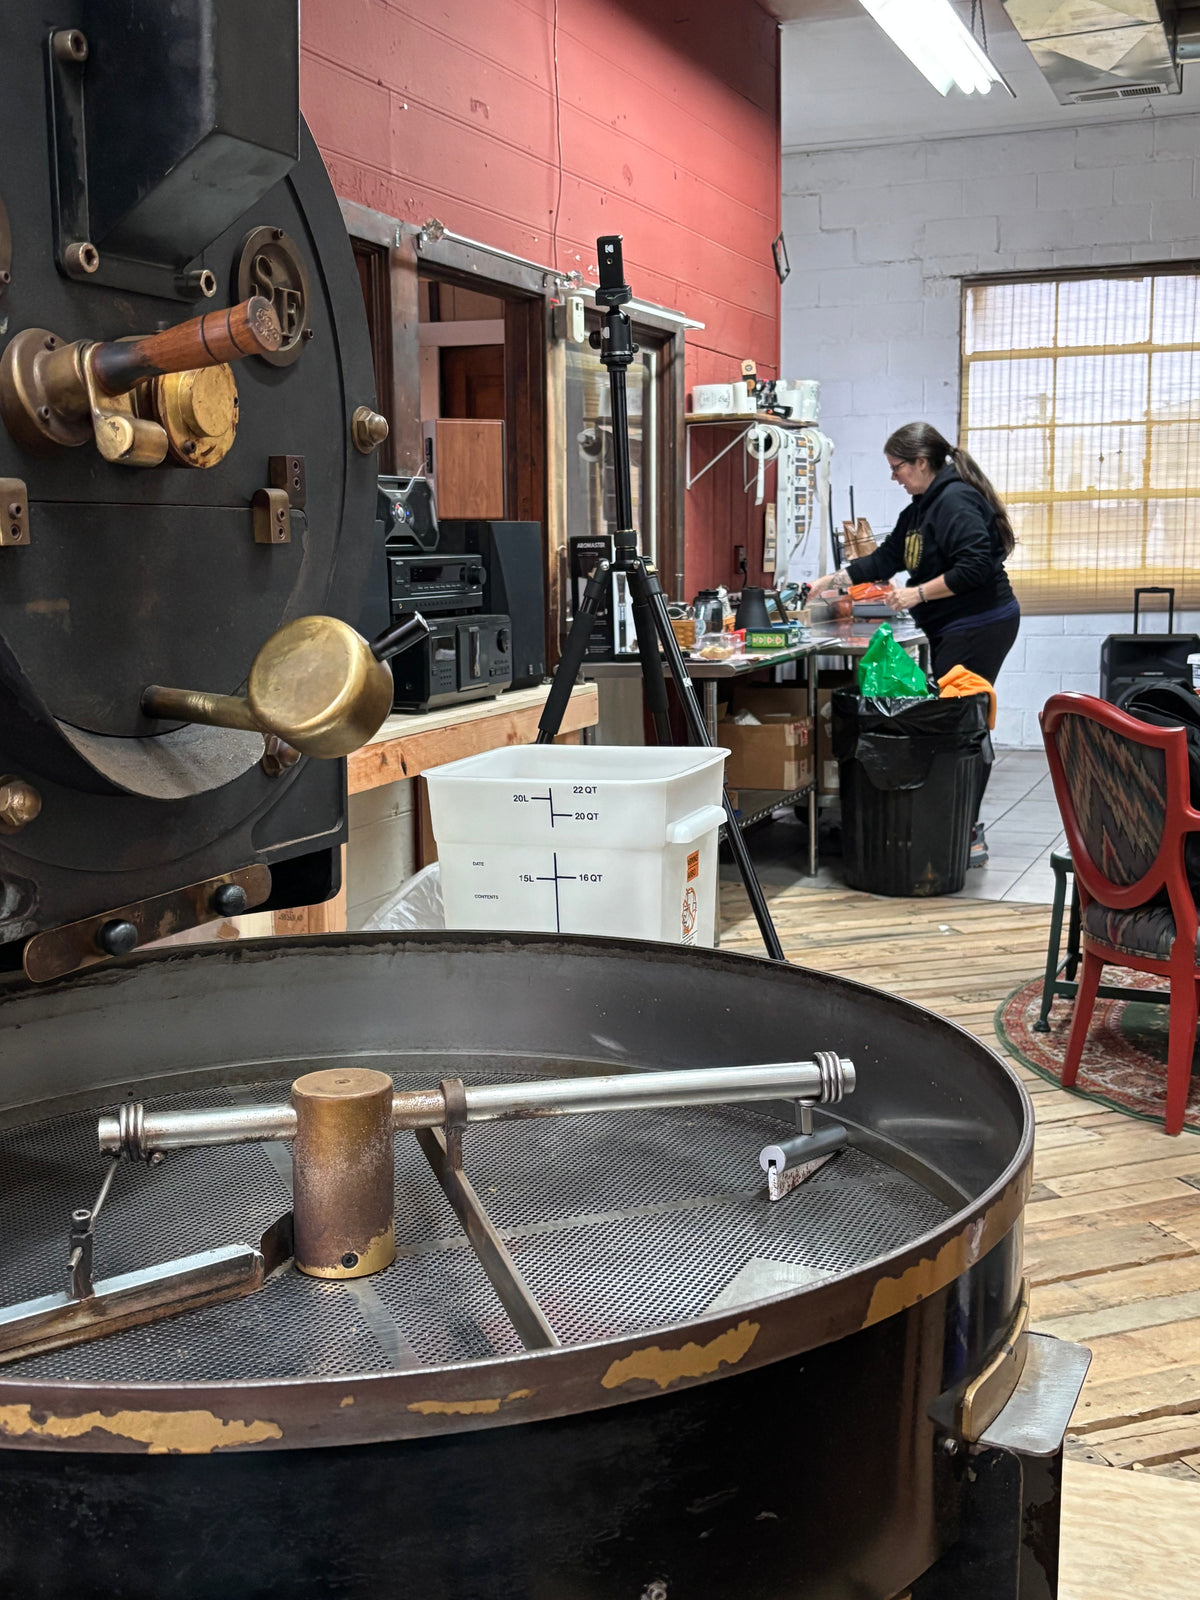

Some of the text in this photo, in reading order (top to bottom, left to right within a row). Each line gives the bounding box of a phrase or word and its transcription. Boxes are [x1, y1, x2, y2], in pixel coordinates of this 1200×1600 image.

[573, 786, 597, 794] 22 QT
[513, 794, 529, 803] 20L
[575, 812, 599, 820] 20 QT
[519, 874, 534, 882] 15L
[579, 874, 603, 882] 16 QT
